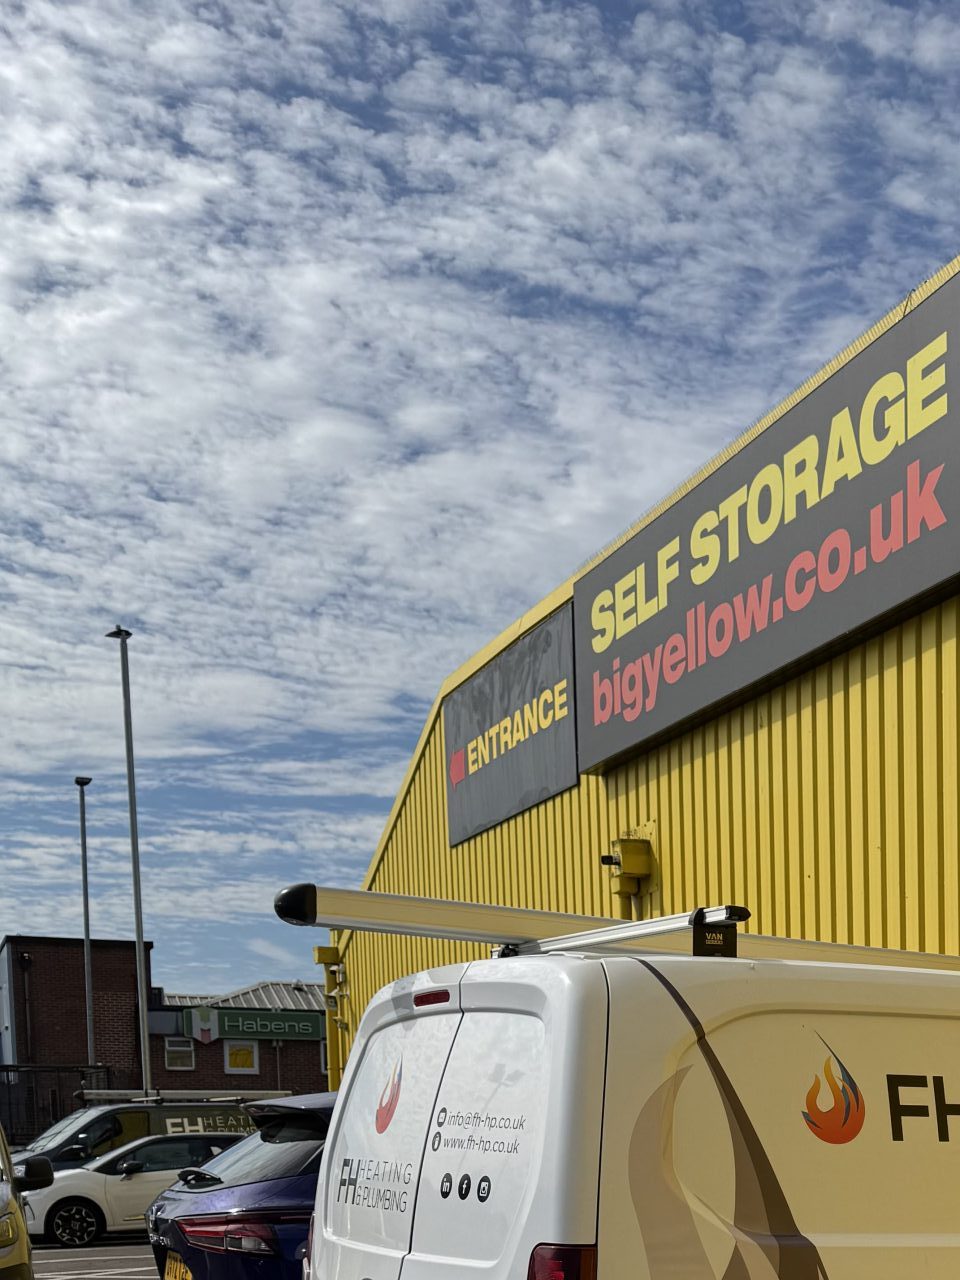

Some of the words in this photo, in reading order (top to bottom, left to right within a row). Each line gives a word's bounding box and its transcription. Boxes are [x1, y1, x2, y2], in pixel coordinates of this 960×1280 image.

[591, 535, 680, 654] SELF
[689, 330, 948, 586] STORAGE
[592, 459, 948, 726] bigyellow.co.uk
[467, 679, 569, 775] ENTRANCE
[706, 933, 723, 941] VAN
[224, 1016, 313, 1033] Habens
[447, 1111, 526, 1131] info@fh-hp.co.uk
[443, 1134, 520, 1154] www.fh-hp.co.uk
[337, 1158, 361, 1205] FH
[359, 1159, 413, 1185] HEATING
[362, 1186, 408, 1213] PLUMBING
